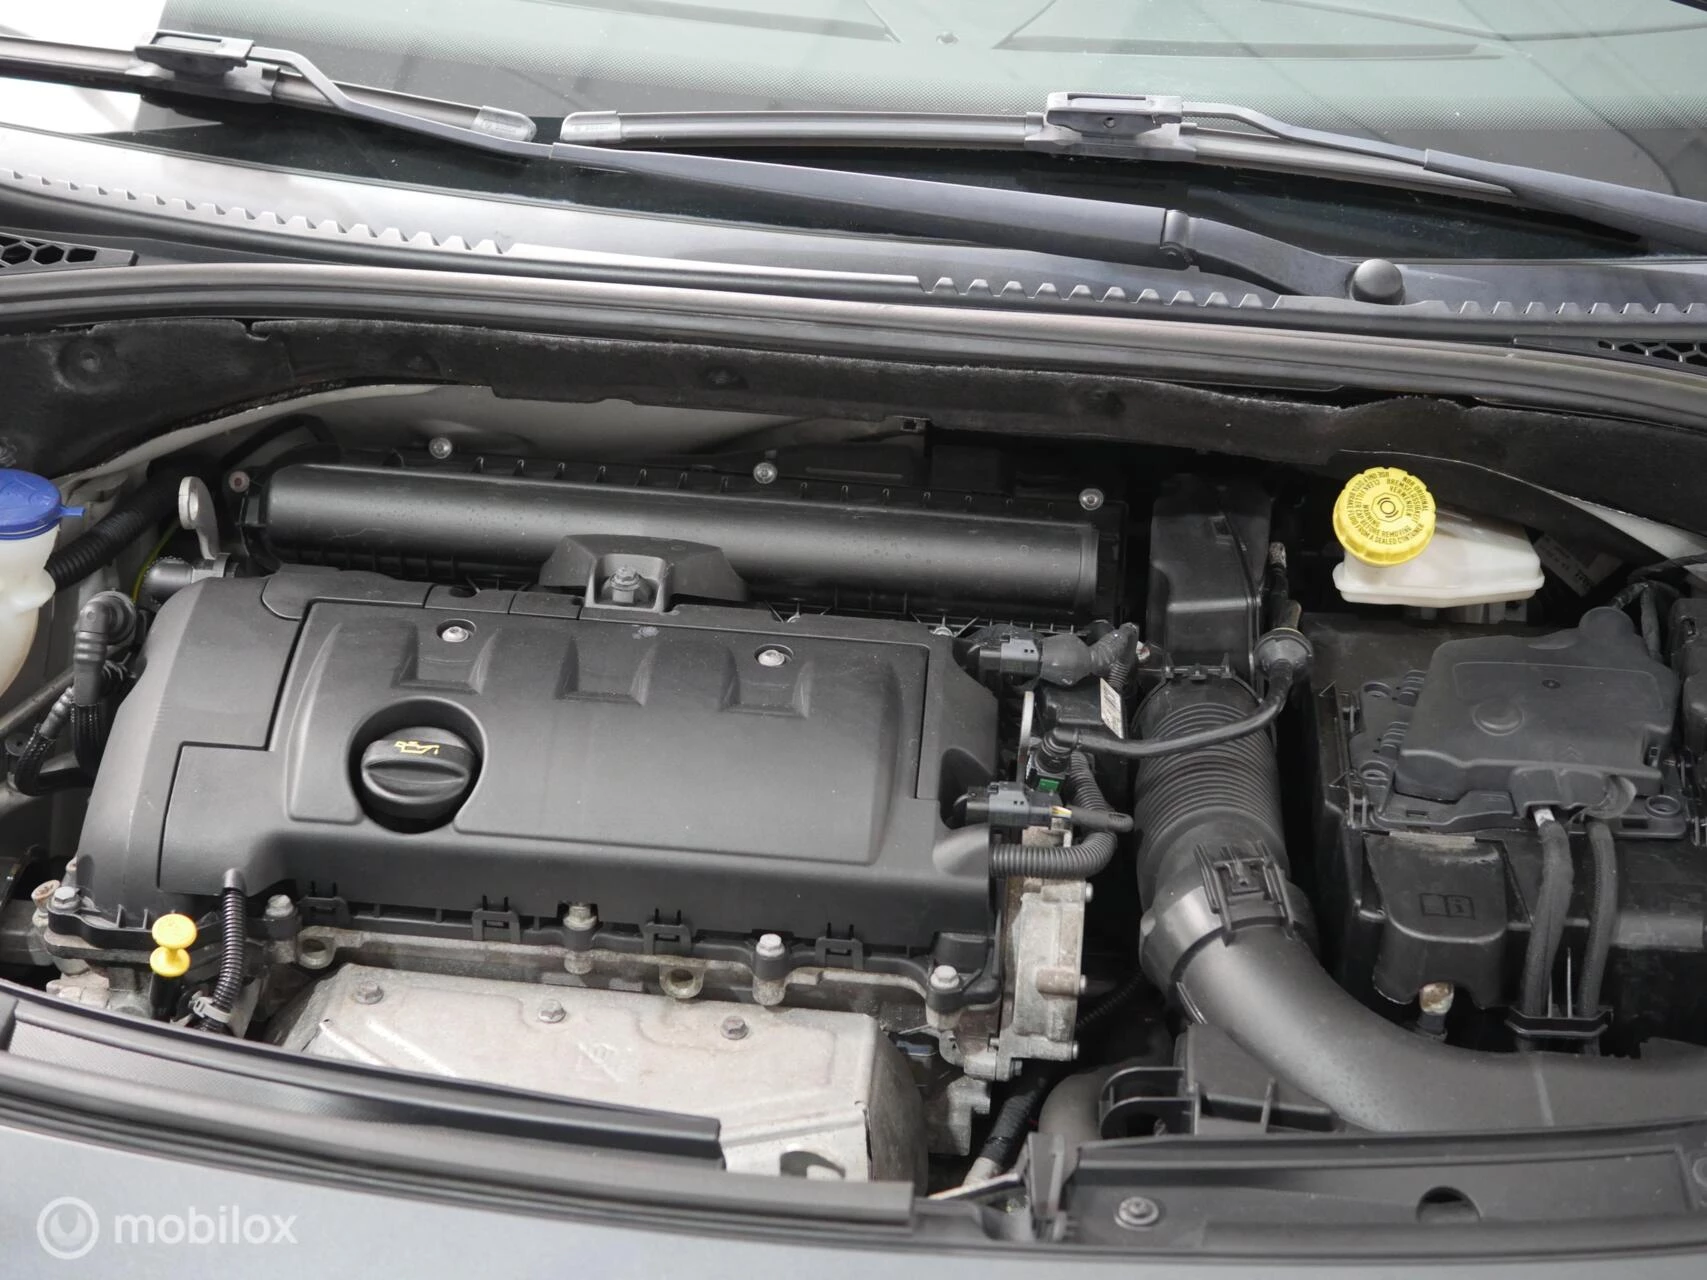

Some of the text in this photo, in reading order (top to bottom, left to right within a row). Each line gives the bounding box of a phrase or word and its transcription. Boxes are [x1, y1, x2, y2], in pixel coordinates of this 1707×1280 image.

[1347, 492, 1356, 509] BRAKE
[1355, 524, 1370, 538] FROM
[1354, 480, 1411, 537] CLEAN FILLER CAP BEFORE REMOVING
[1363, 505, 1380, 527] WARNING
[1414, 485, 1428, 511] ORIGINAL
